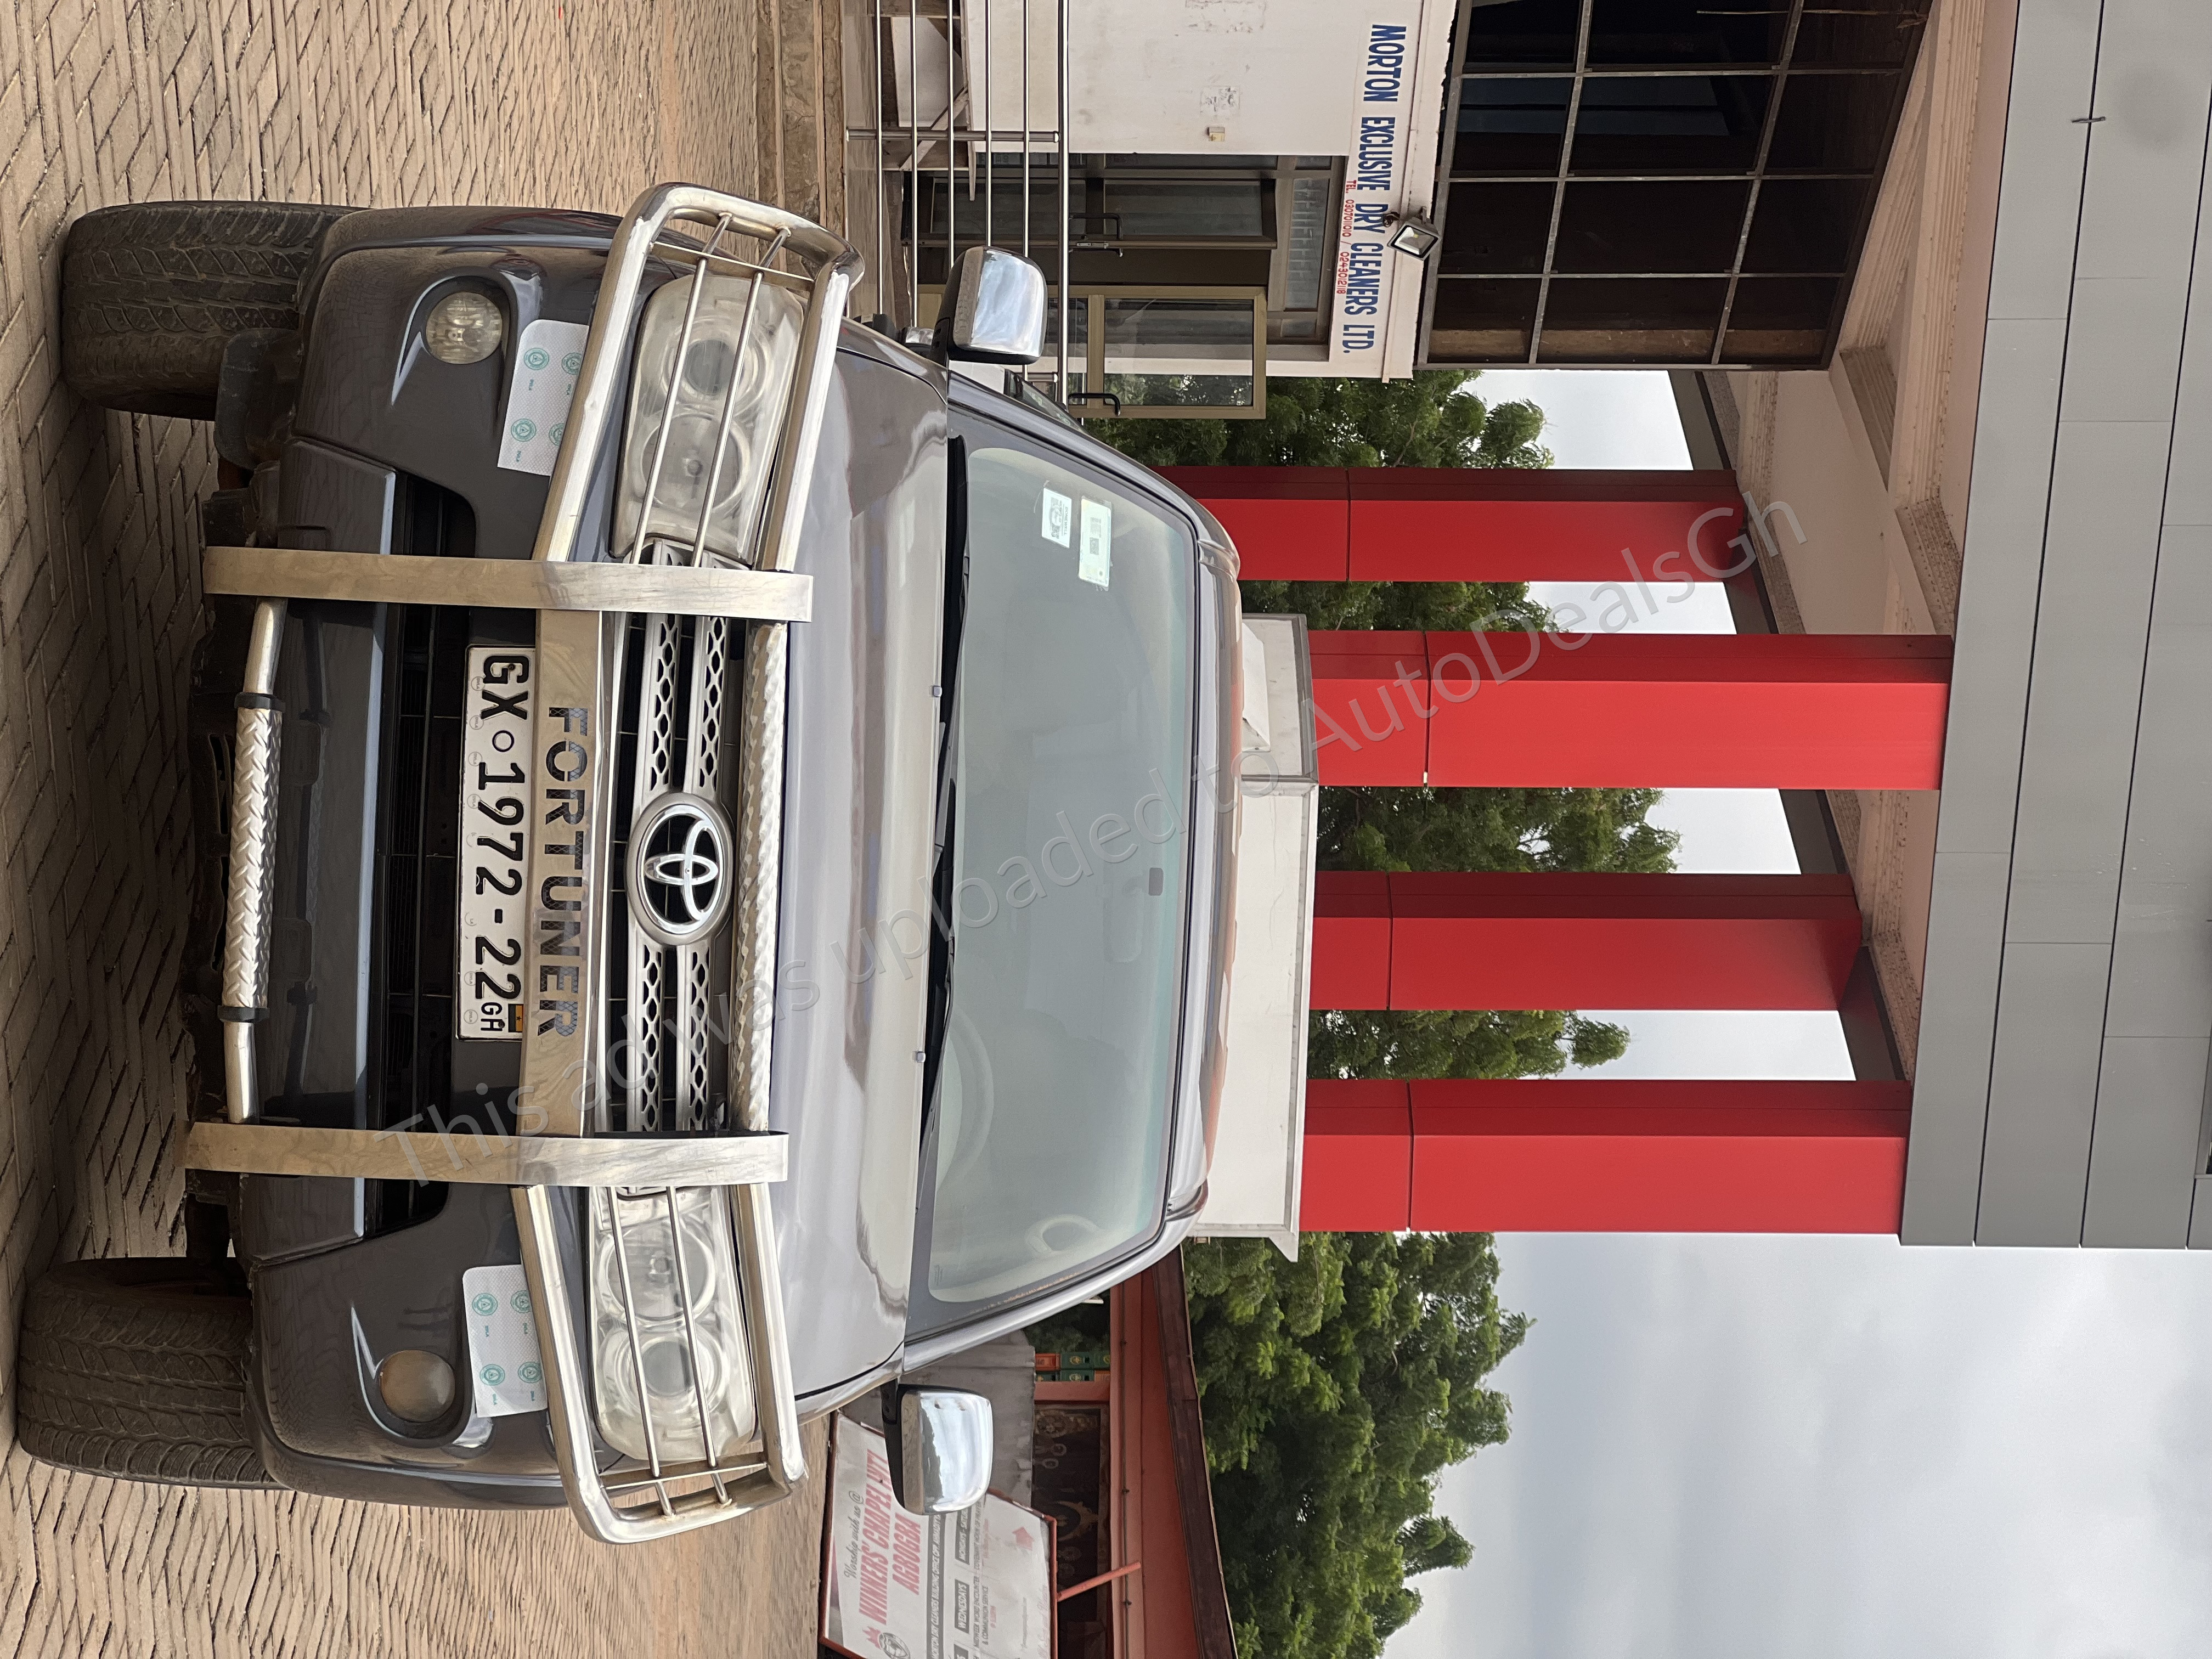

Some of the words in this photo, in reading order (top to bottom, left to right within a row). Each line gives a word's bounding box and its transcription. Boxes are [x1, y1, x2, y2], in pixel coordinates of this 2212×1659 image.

[1364, 24, 1407, 102] MORTON
[1357, 117, 1396, 190] EXCLUSIVE
[1345, 180, 1356, 193] TEL.
[1342, 199, 1354, 237] 0307011010
[1353, 204, 1389, 234] DRY
[1336, 252, 1350, 294] 0243012118
[1344, 242, 1384, 315] CLEANERS
[1342, 325, 1375, 353] LTD.
[481, 655, 529, 720] GX
[538, 707, 588, 1037] FORTUNER
[481, 1002, 503, 1031] GH
[849, 1491, 864, 1504] @
[854, 1506, 860, 1517] us
[862, 1483, 892, 1549] CHAPEL
[848, 1516, 860, 1541] with
[844, 1543, 862, 1579] Worship
[893, 1513, 920, 1595] AGBOGBA
[859, 1541, 888, 1625] WINNERS'
[958, 1583, 967, 1628] WEDNESDAYS
